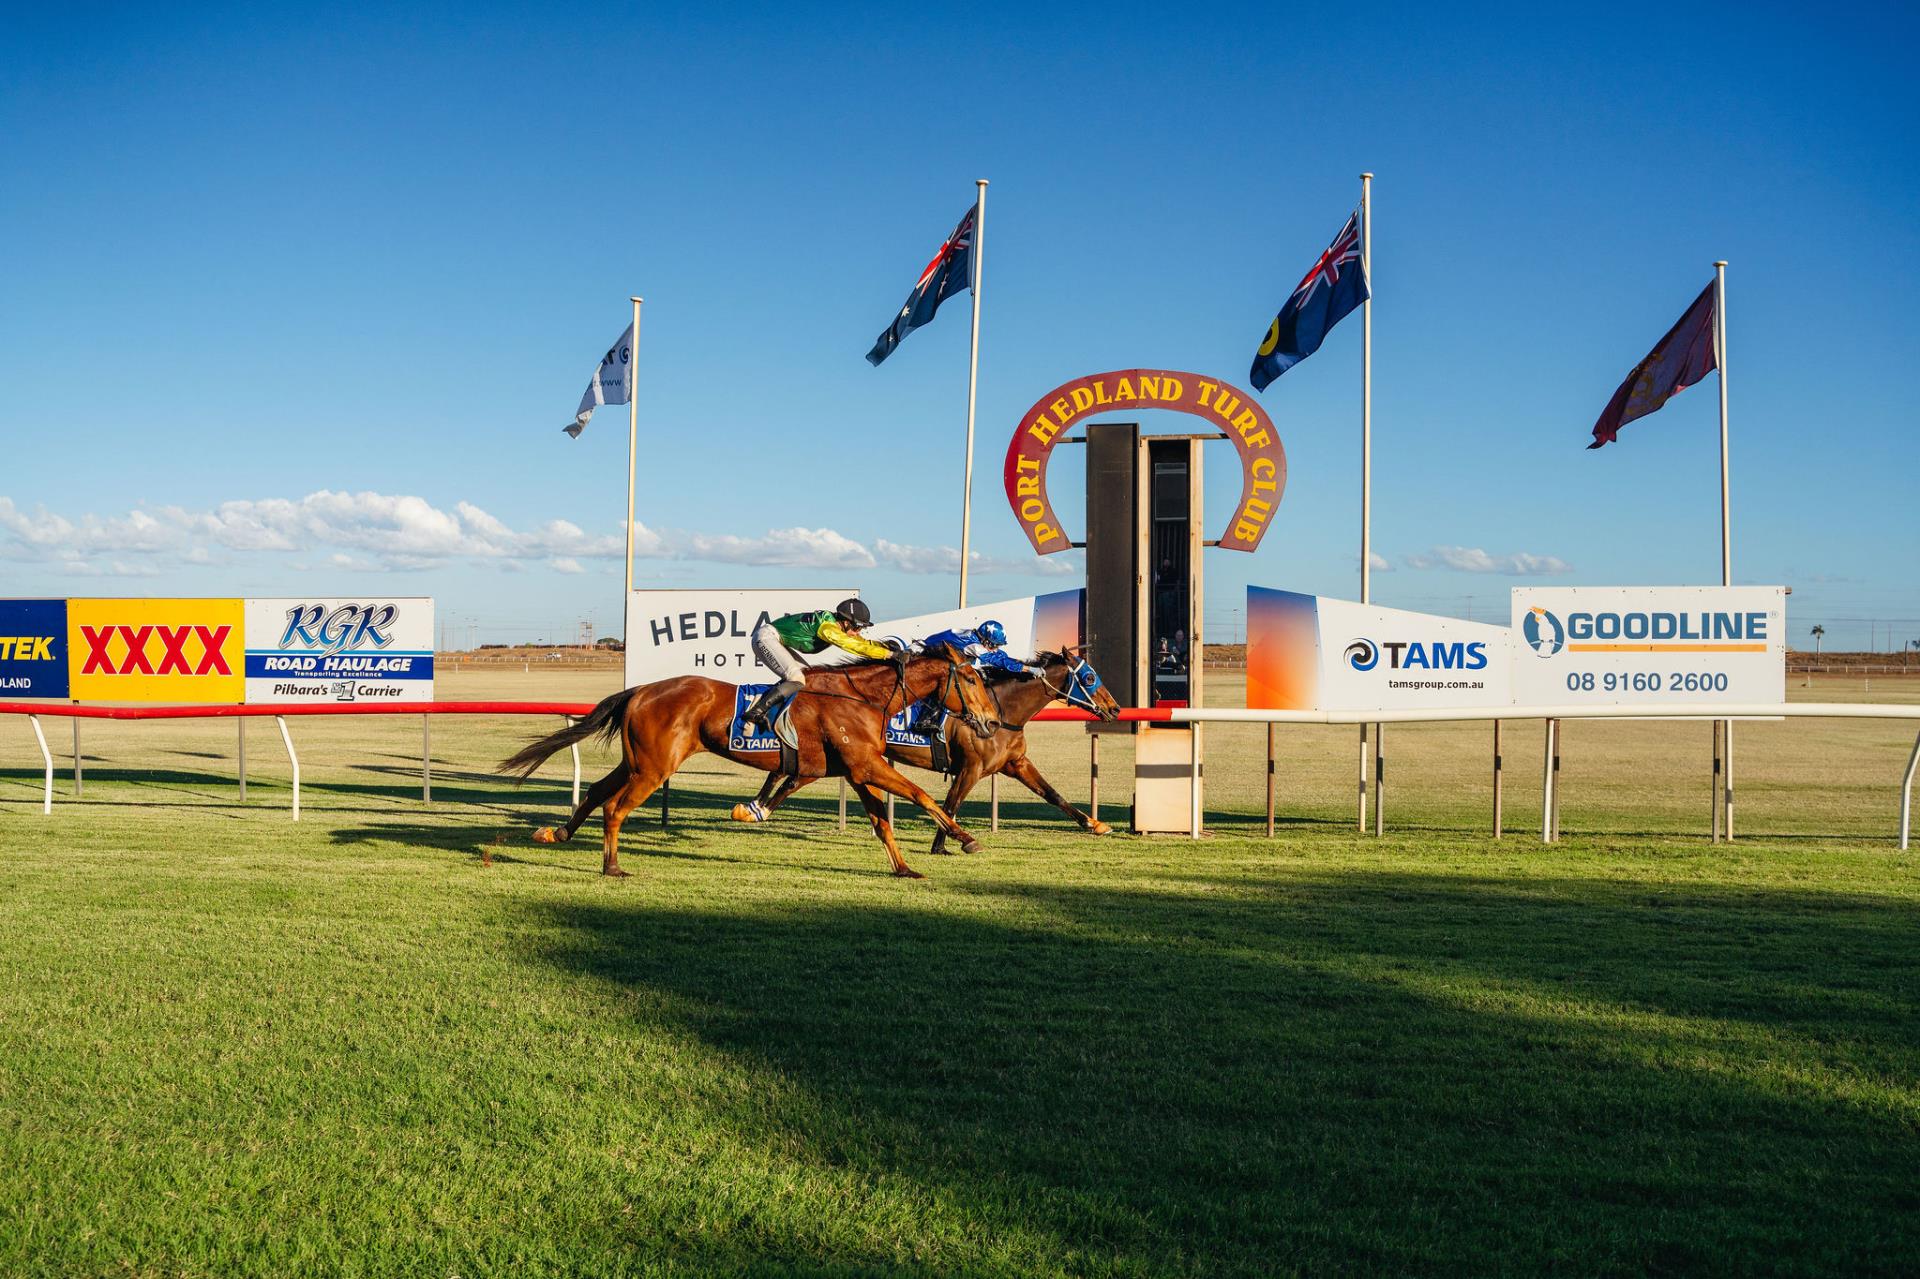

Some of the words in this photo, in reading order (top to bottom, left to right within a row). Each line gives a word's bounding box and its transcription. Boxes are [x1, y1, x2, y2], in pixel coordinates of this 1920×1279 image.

[1028, 376, 1183, 446] HEDLAND
[1197, 380, 1272, 449] TURF
[1016, 453, 1059, 545] PORT
[1234, 456, 1277, 543] CLUB
[278, 603, 399, 659] RGR
[650, 610, 790, 647] HEDLA
[1567, 612, 1767, 640] GOODLINE
[79, 625, 233, 676] XXXX
[694, 653, 764, 667] HOTE
[760, 645, 780, 670] BENNETT
[1383, 642, 1488, 670] TAMS
[264, 657, 317, 671] ROAD
[323, 657, 413, 672] HAULAGE
[294, 670, 340, 678] Transporting
[0, 677, 31, 689] LAND
[273, 684, 328, 697] Pilbara's
[358, 684, 403, 697] Carrier
[1388, 679, 1484, 691] tamsgroup.com.au
[1566, 672, 1595, 692] 08
[1603, 672, 1662, 692] 9160
[1669, 672, 1728, 692] 2600
[745, 738, 780, 749] TAMS
[895, 731, 926, 744] TAMS
